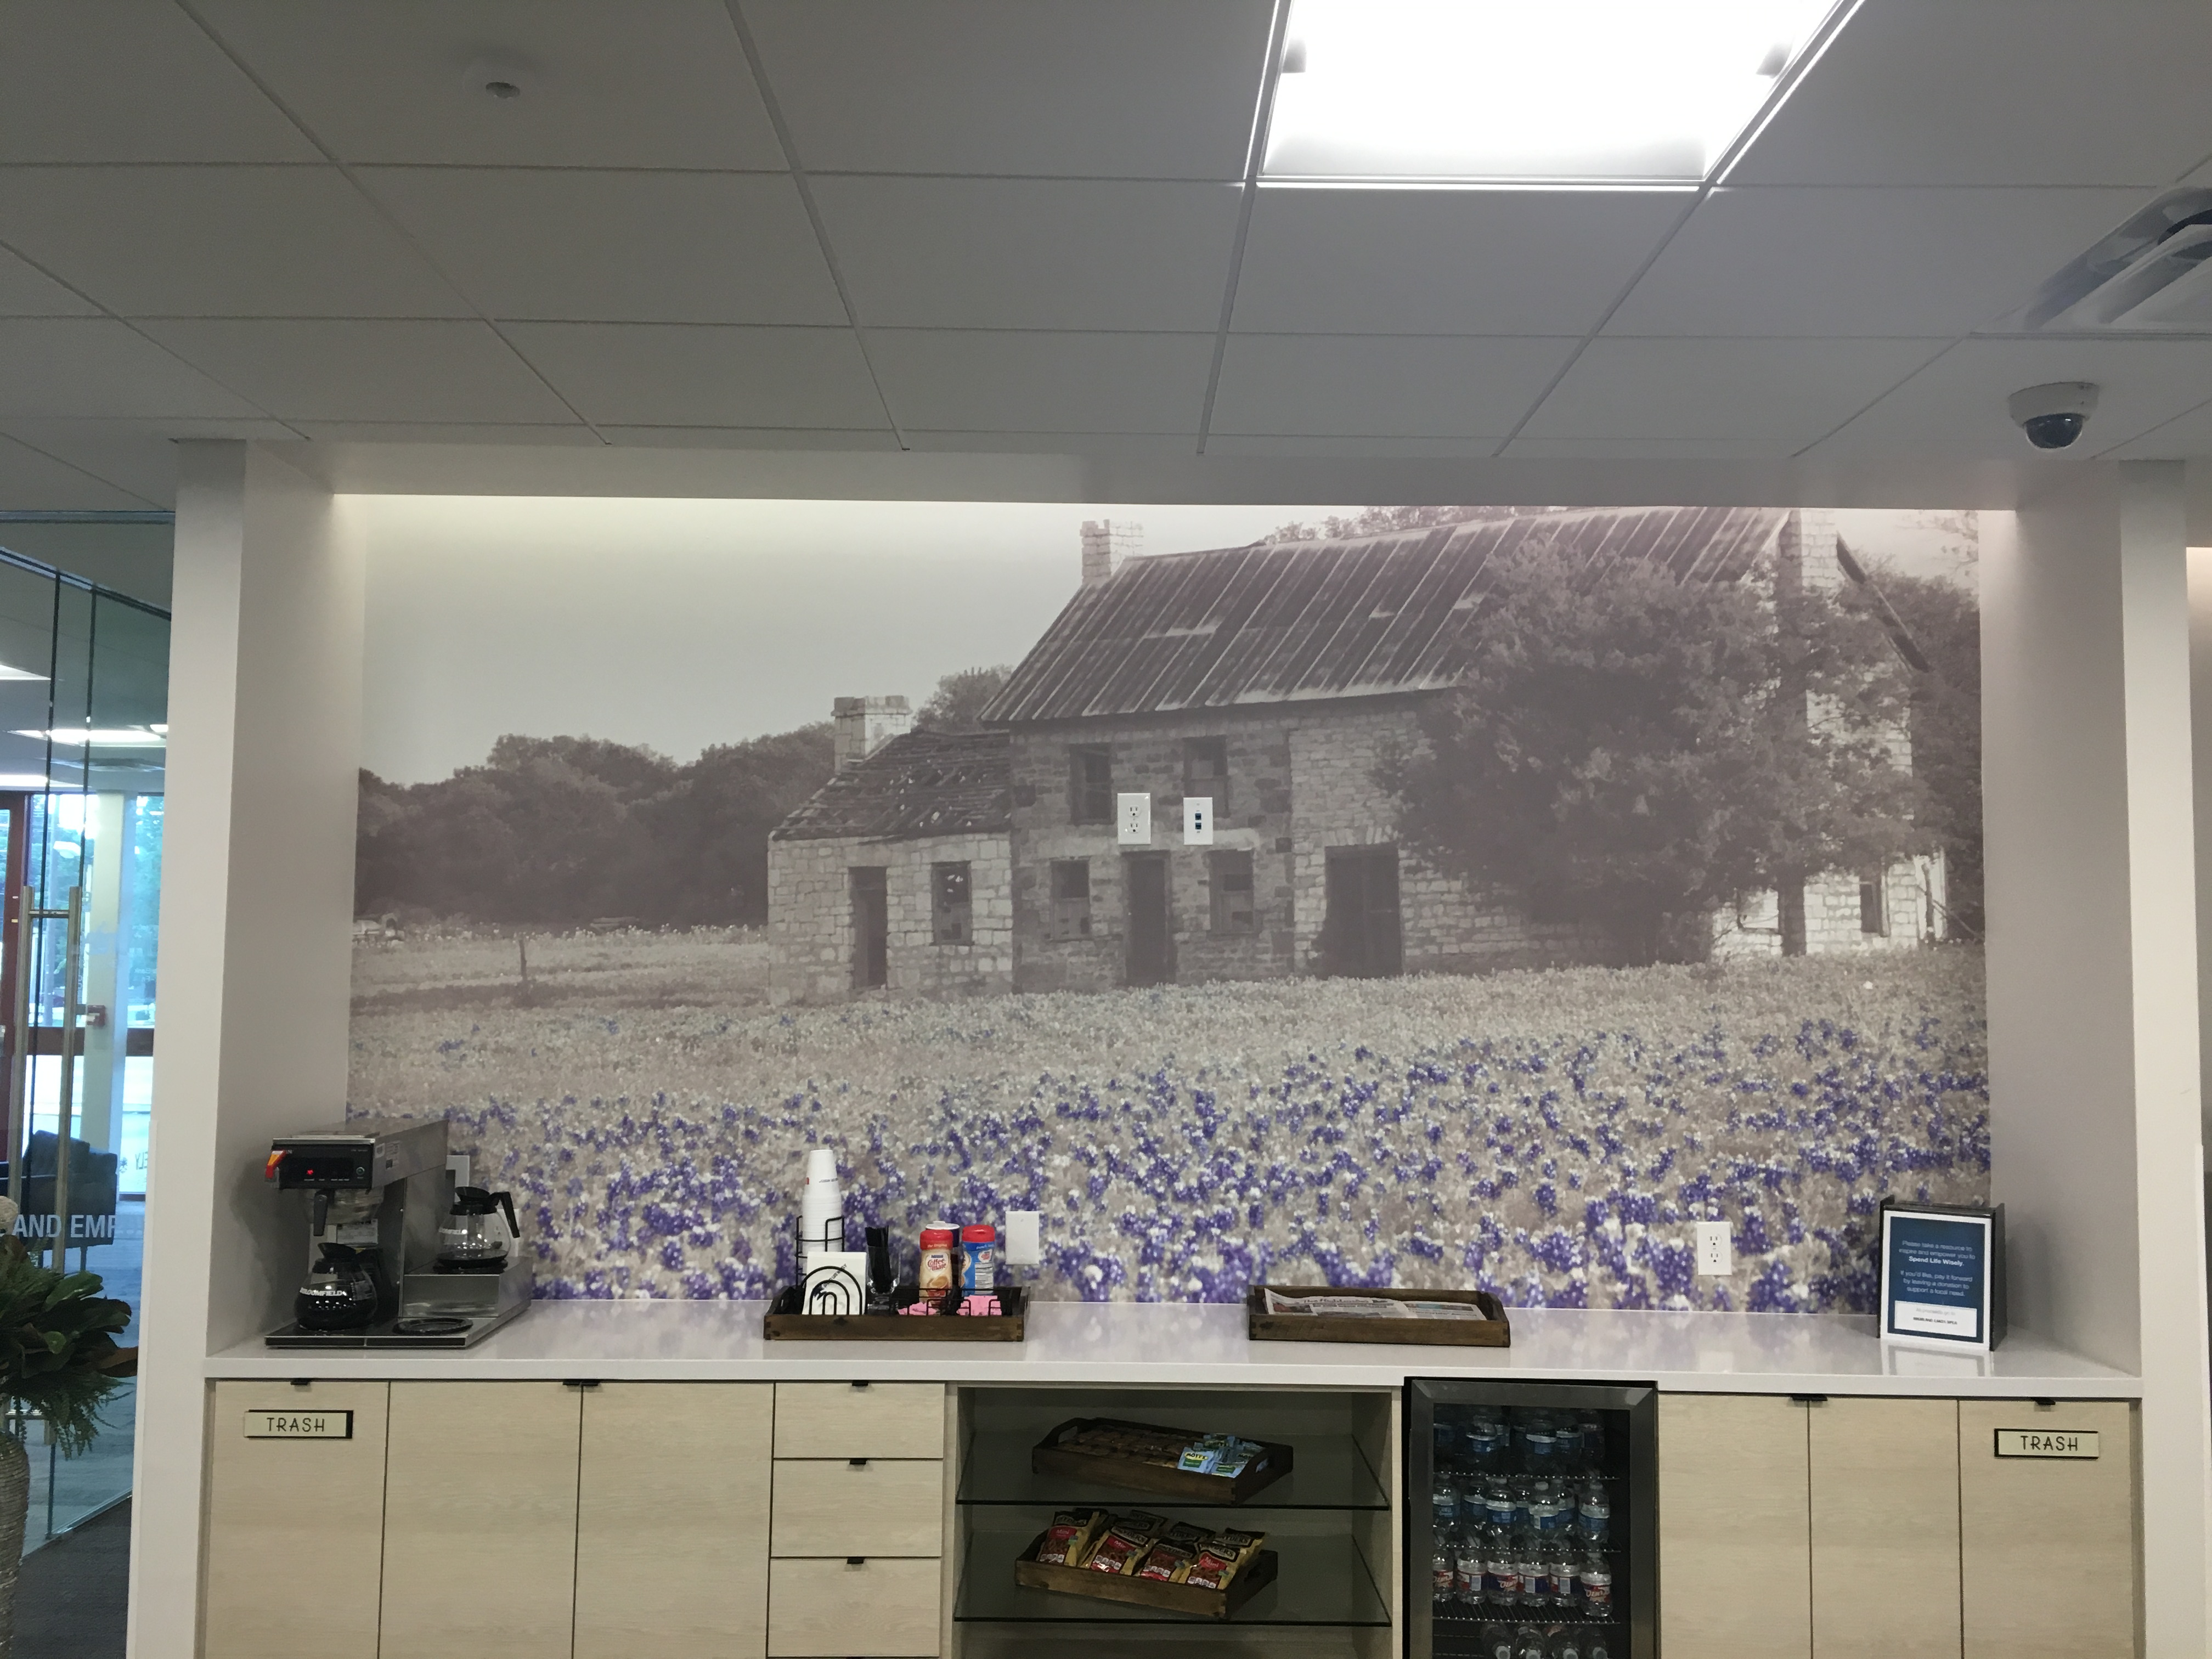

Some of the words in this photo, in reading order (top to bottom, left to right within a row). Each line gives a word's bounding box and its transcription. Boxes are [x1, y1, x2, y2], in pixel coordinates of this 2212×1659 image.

[12, 1215, 61, 1238] AND
[928, 1259, 945, 1267] Coffee
[300, 1287, 343, 1296] BLOOMFIELD
[267, 1417, 325, 1432] TRASH
[2021, 1435, 2078, 1452] TRASH
